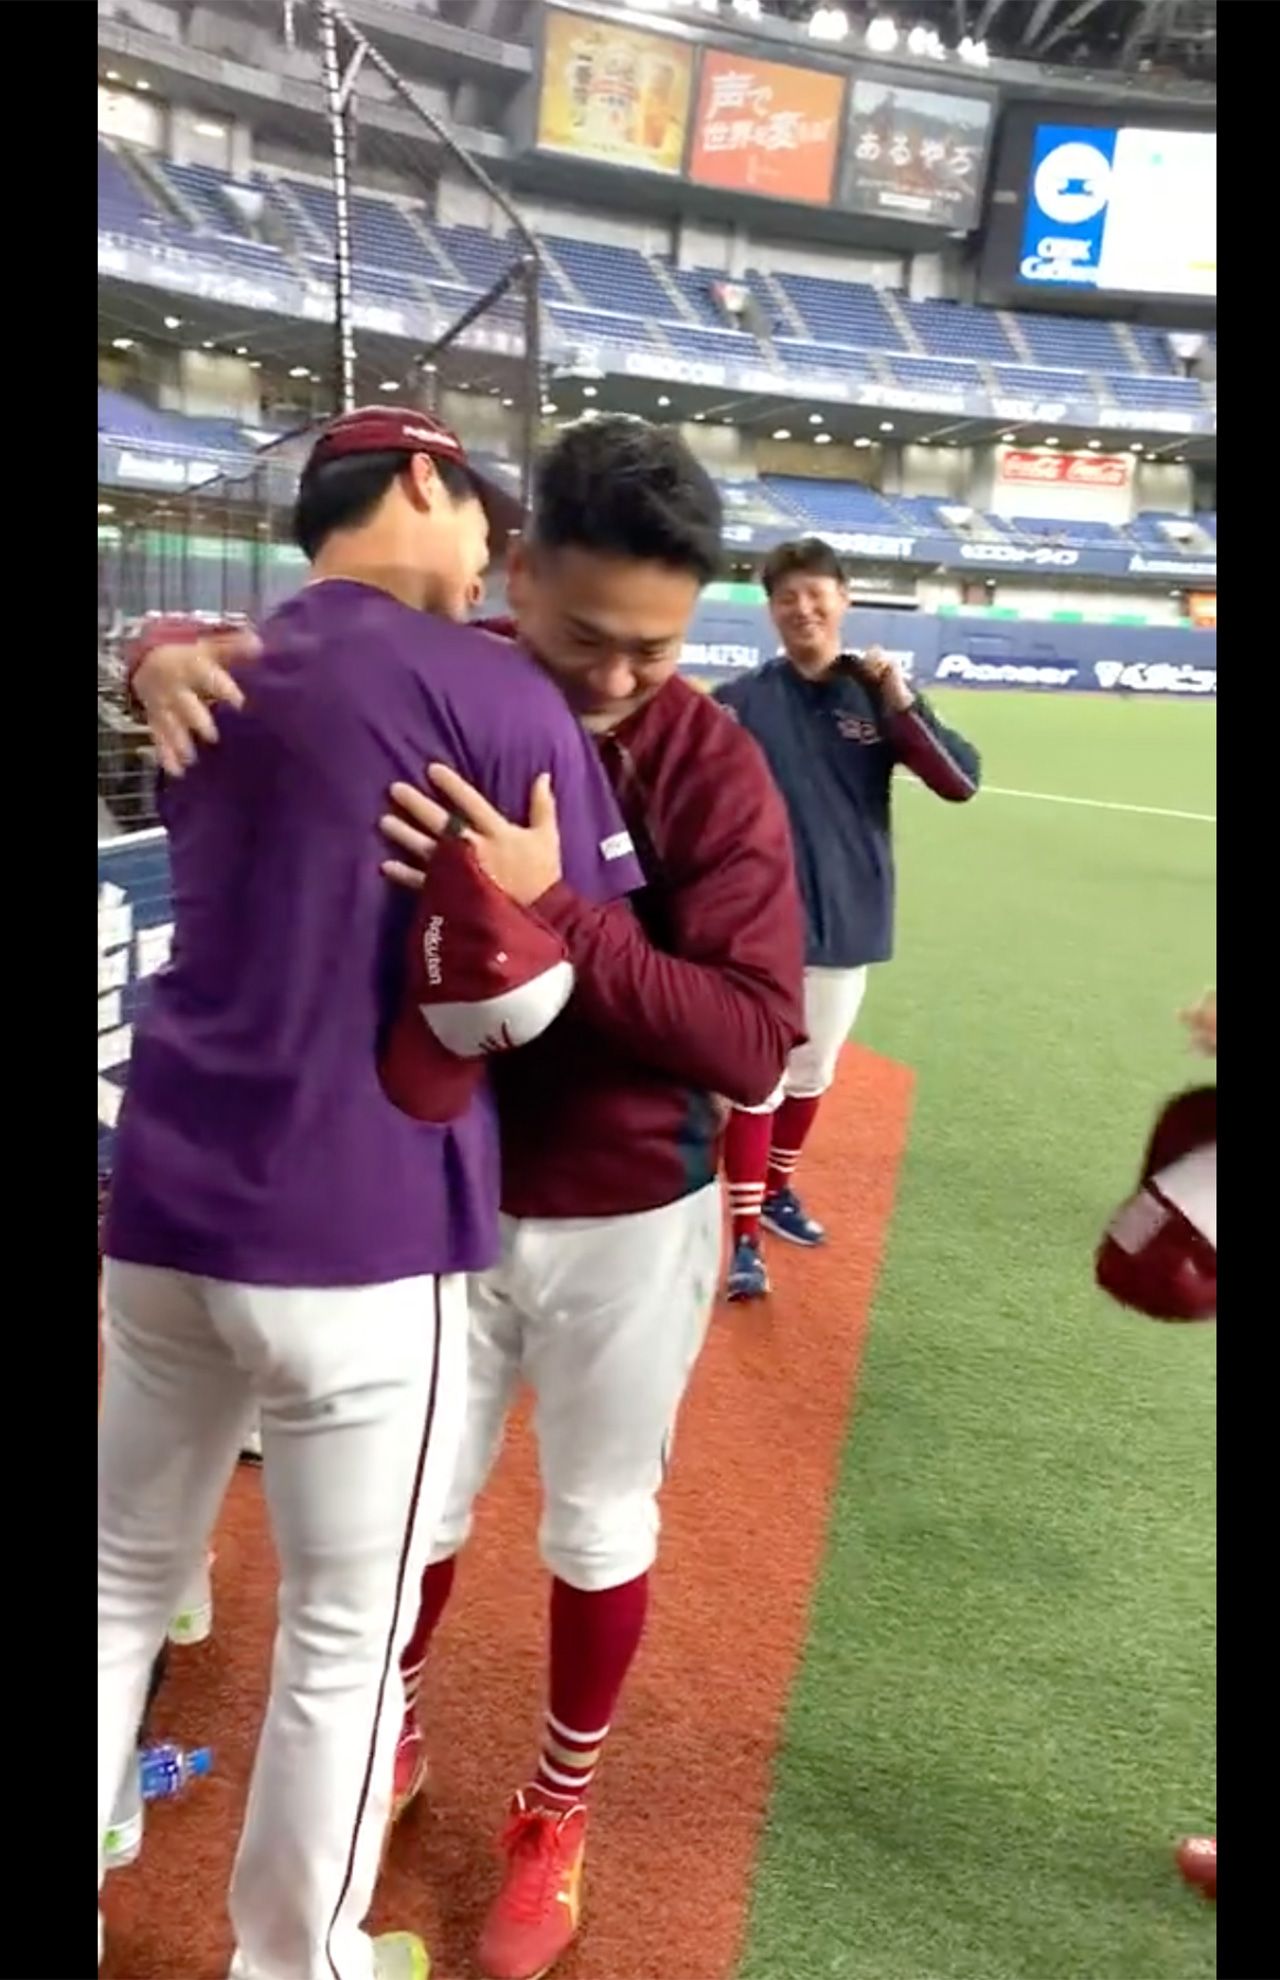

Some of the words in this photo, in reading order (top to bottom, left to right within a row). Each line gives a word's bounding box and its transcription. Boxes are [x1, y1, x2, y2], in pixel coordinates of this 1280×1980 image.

[705, 70, 774, 119] 声で
[854, 132, 984, 175] あるやろ
[934, 653, 1078, 685] Pioneer
[423, 914, 445, 986] Rakuten
